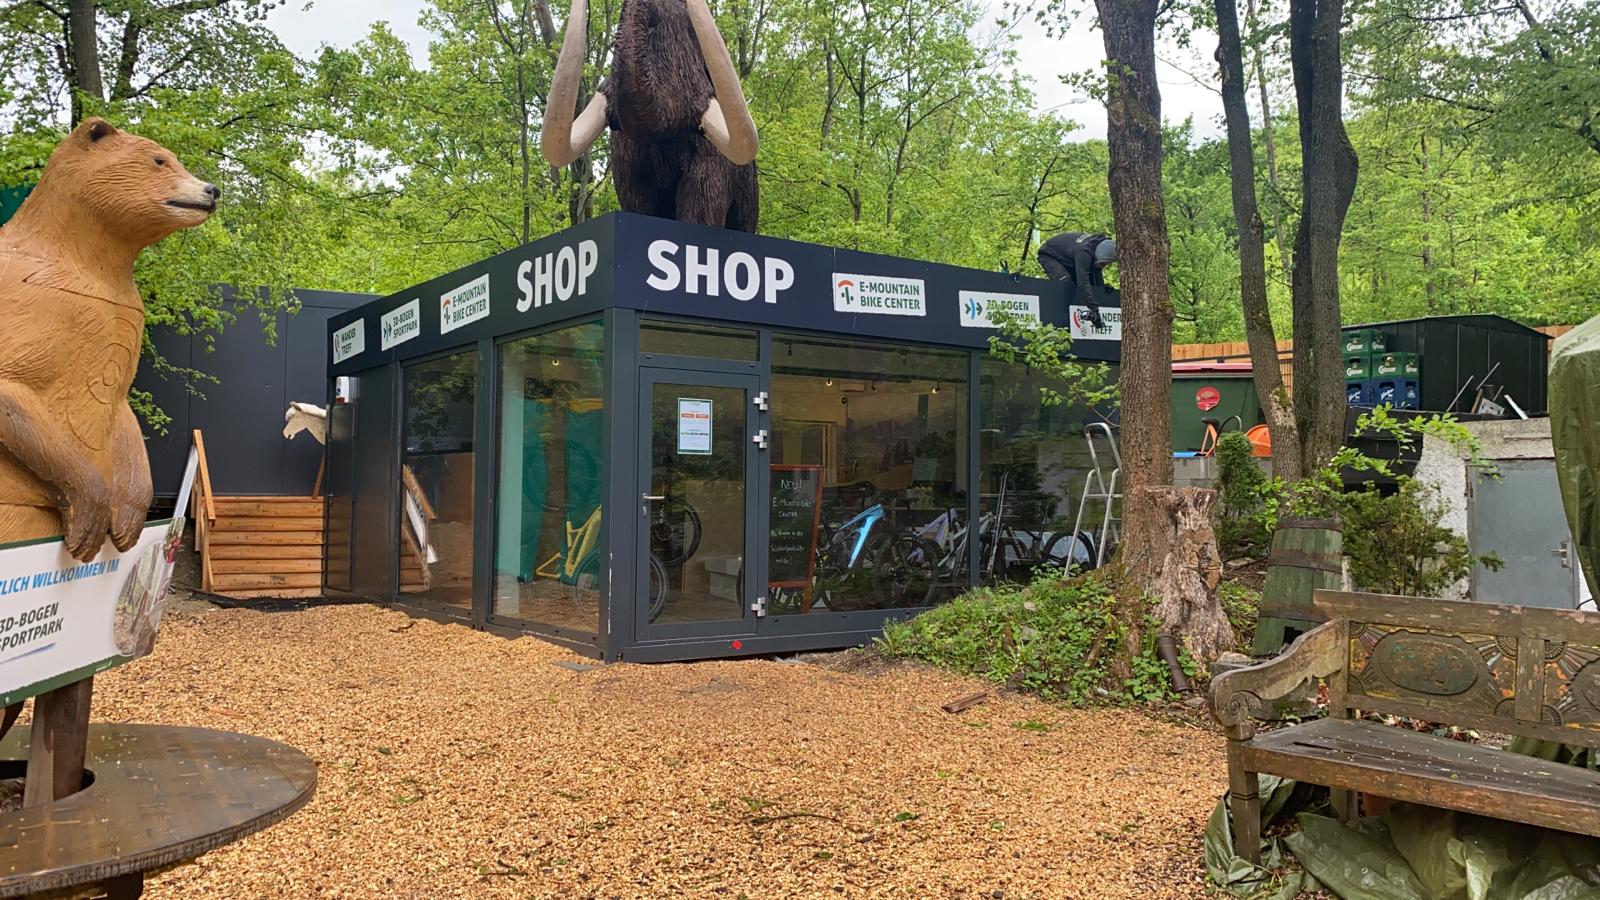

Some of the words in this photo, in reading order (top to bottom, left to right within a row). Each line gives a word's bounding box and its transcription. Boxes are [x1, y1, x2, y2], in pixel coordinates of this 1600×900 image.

[515, 239, 599, 313] SHOP
[645, 239, 795, 304] SHOP
[452, 282, 487, 308] E-MOUNTAIN
[859, 281, 920, 296] E-MOUNTAIN
[452, 306, 465, 323] BIKE
[465, 300, 487, 318] CENTER
[860, 296, 883, 308] BIKE
[884, 297, 921, 310] CENTER
[392, 309, 415, 327] 3D-BOGEN
[393, 319, 419, 339] SPORTPARK
[1089, 325, 1113, 335] TREFF
[32, 562, 106, 589] WILLKOMMEN
[107, 558, 120, 573] IM
[0, 602, 59, 634] 3D-BOGEN
